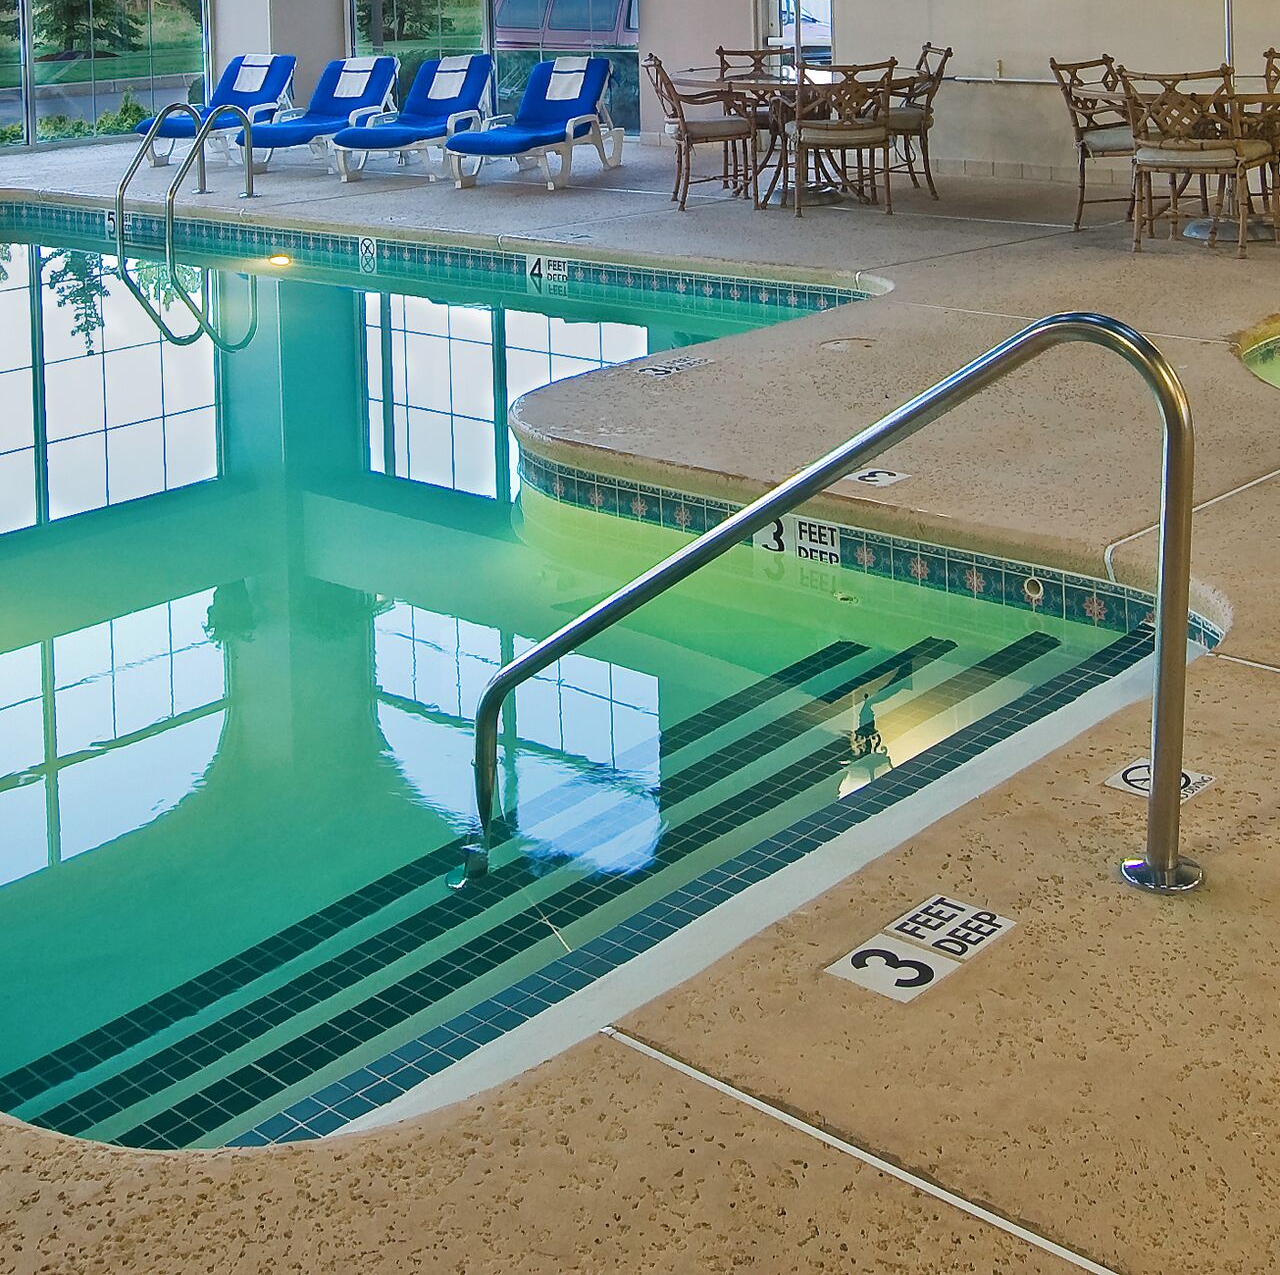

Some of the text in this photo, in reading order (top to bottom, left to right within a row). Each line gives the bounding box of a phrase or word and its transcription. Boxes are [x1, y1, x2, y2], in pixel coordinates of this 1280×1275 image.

[530, 257, 567, 278] 4 FEET
[761, 518, 837, 552] 3 FEET
[850, 897, 966, 987] 3 FEET
[931, 911, 1003, 956] DEEP
